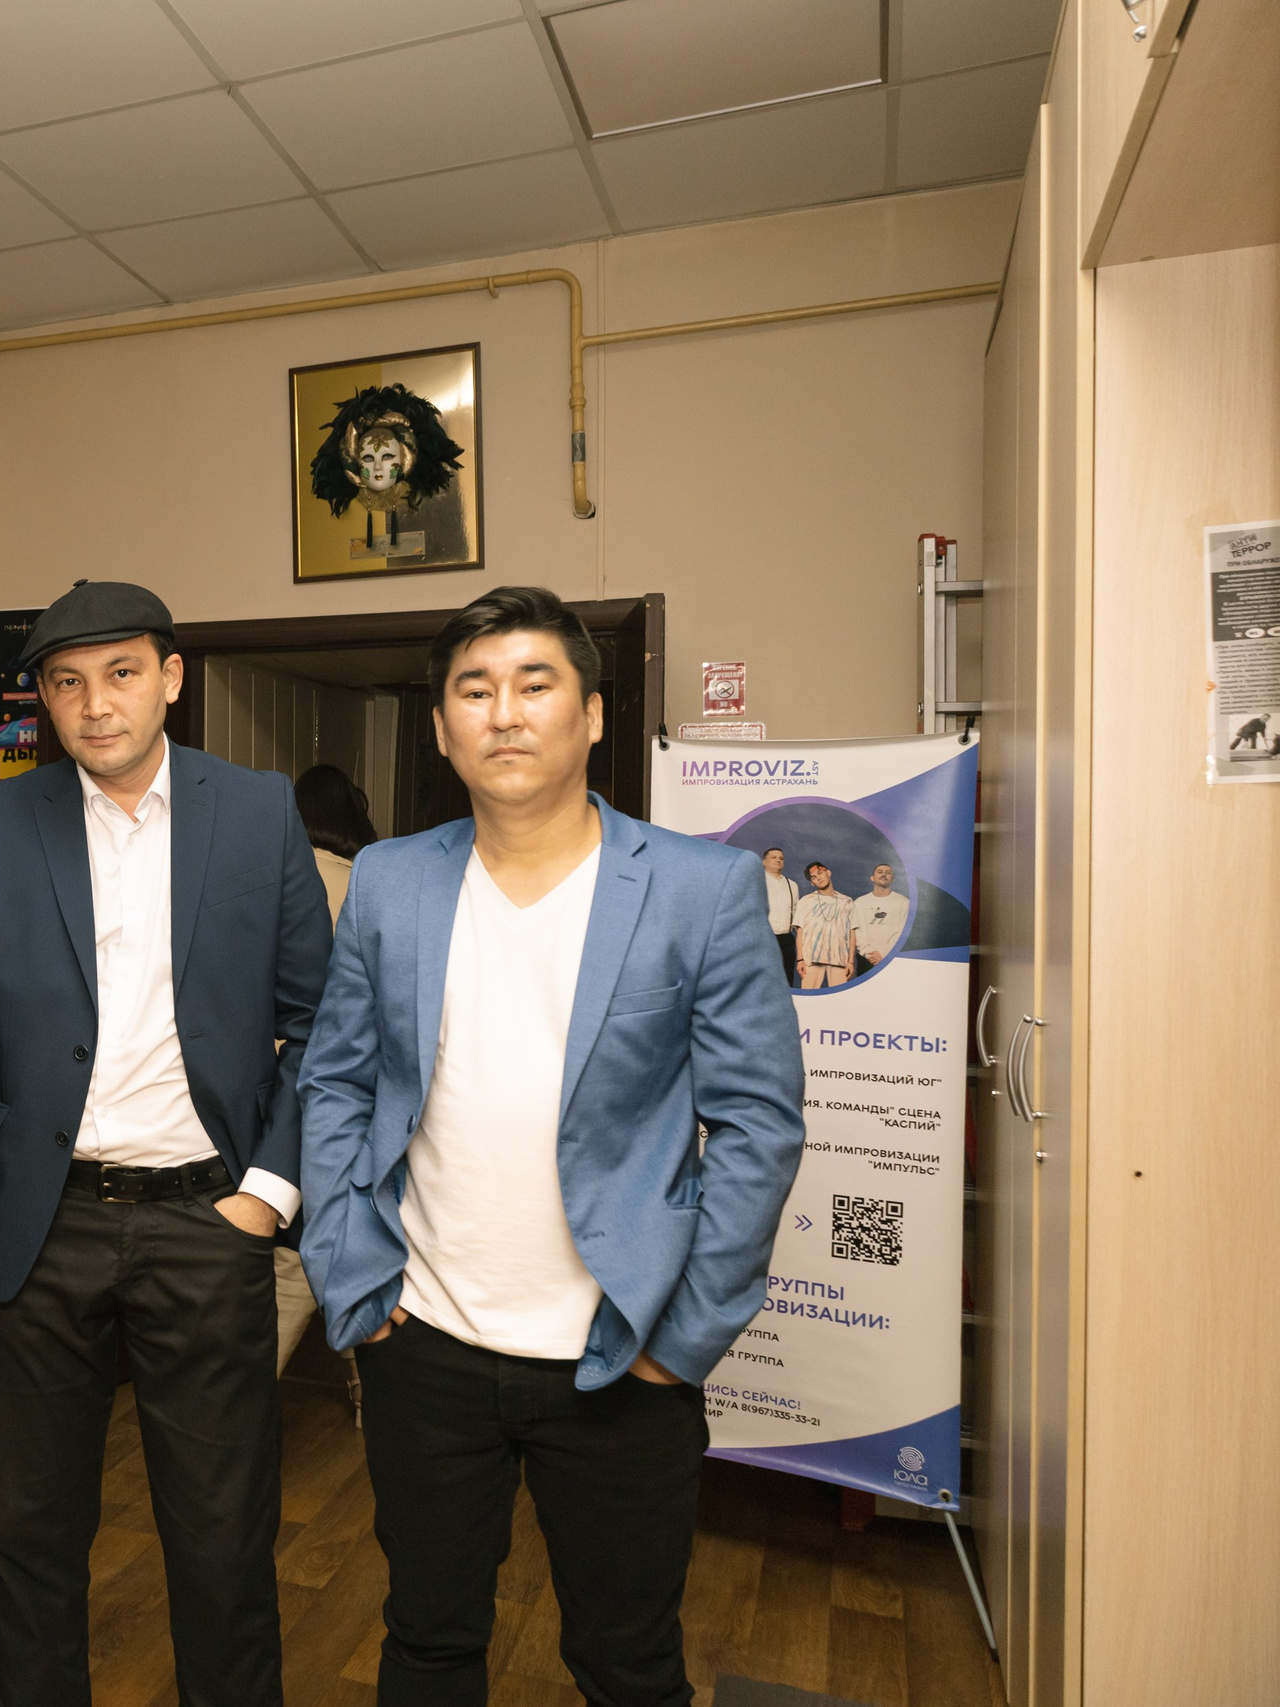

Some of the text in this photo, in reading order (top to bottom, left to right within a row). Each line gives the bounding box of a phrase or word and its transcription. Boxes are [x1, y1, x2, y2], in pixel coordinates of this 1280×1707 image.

[1230, 541, 1271, 558] ТЕРРОР
[2, 748, 38, 763] ДЫ
[682, 760, 811, 777] IMPROVIZ.
[682, 778, 818, 786] ИМПРОВИЗАЦИЯ АСТРАХАНЬ
[800, 1028, 947, 1053] И ПРОЕКТЫ:
[810, 1068, 914, 1085] ИМПРОВИЗАЦИЙ
[803, 1099, 823, 1109] ИЯ.
[898, 1107, 942, 1119] СЦЕНА
[879, 1117, 941, 1131] "КАСПИЙ"
[804, 1141, 940, 1164] НОЙ ИМПРОВИЗАЦИИ
[867, 1160, 940, 1176] "ИМПУЛЬС"
[768, 1275, 845, 1301] РУППЫ
[761, 1296, 890, 1330] ОВИЗАЦИИ:
[739, 1327, 780, 1342] РУППА
[738, 1351, 784, 1368] ГРУППА
[702, 1382, 801, 1411] ШИСЬ СЕЙЧАС!
[714, 1398, 739, 1410] W/A
[741, 1403, 820, 1427] 8(967)335-33-21
